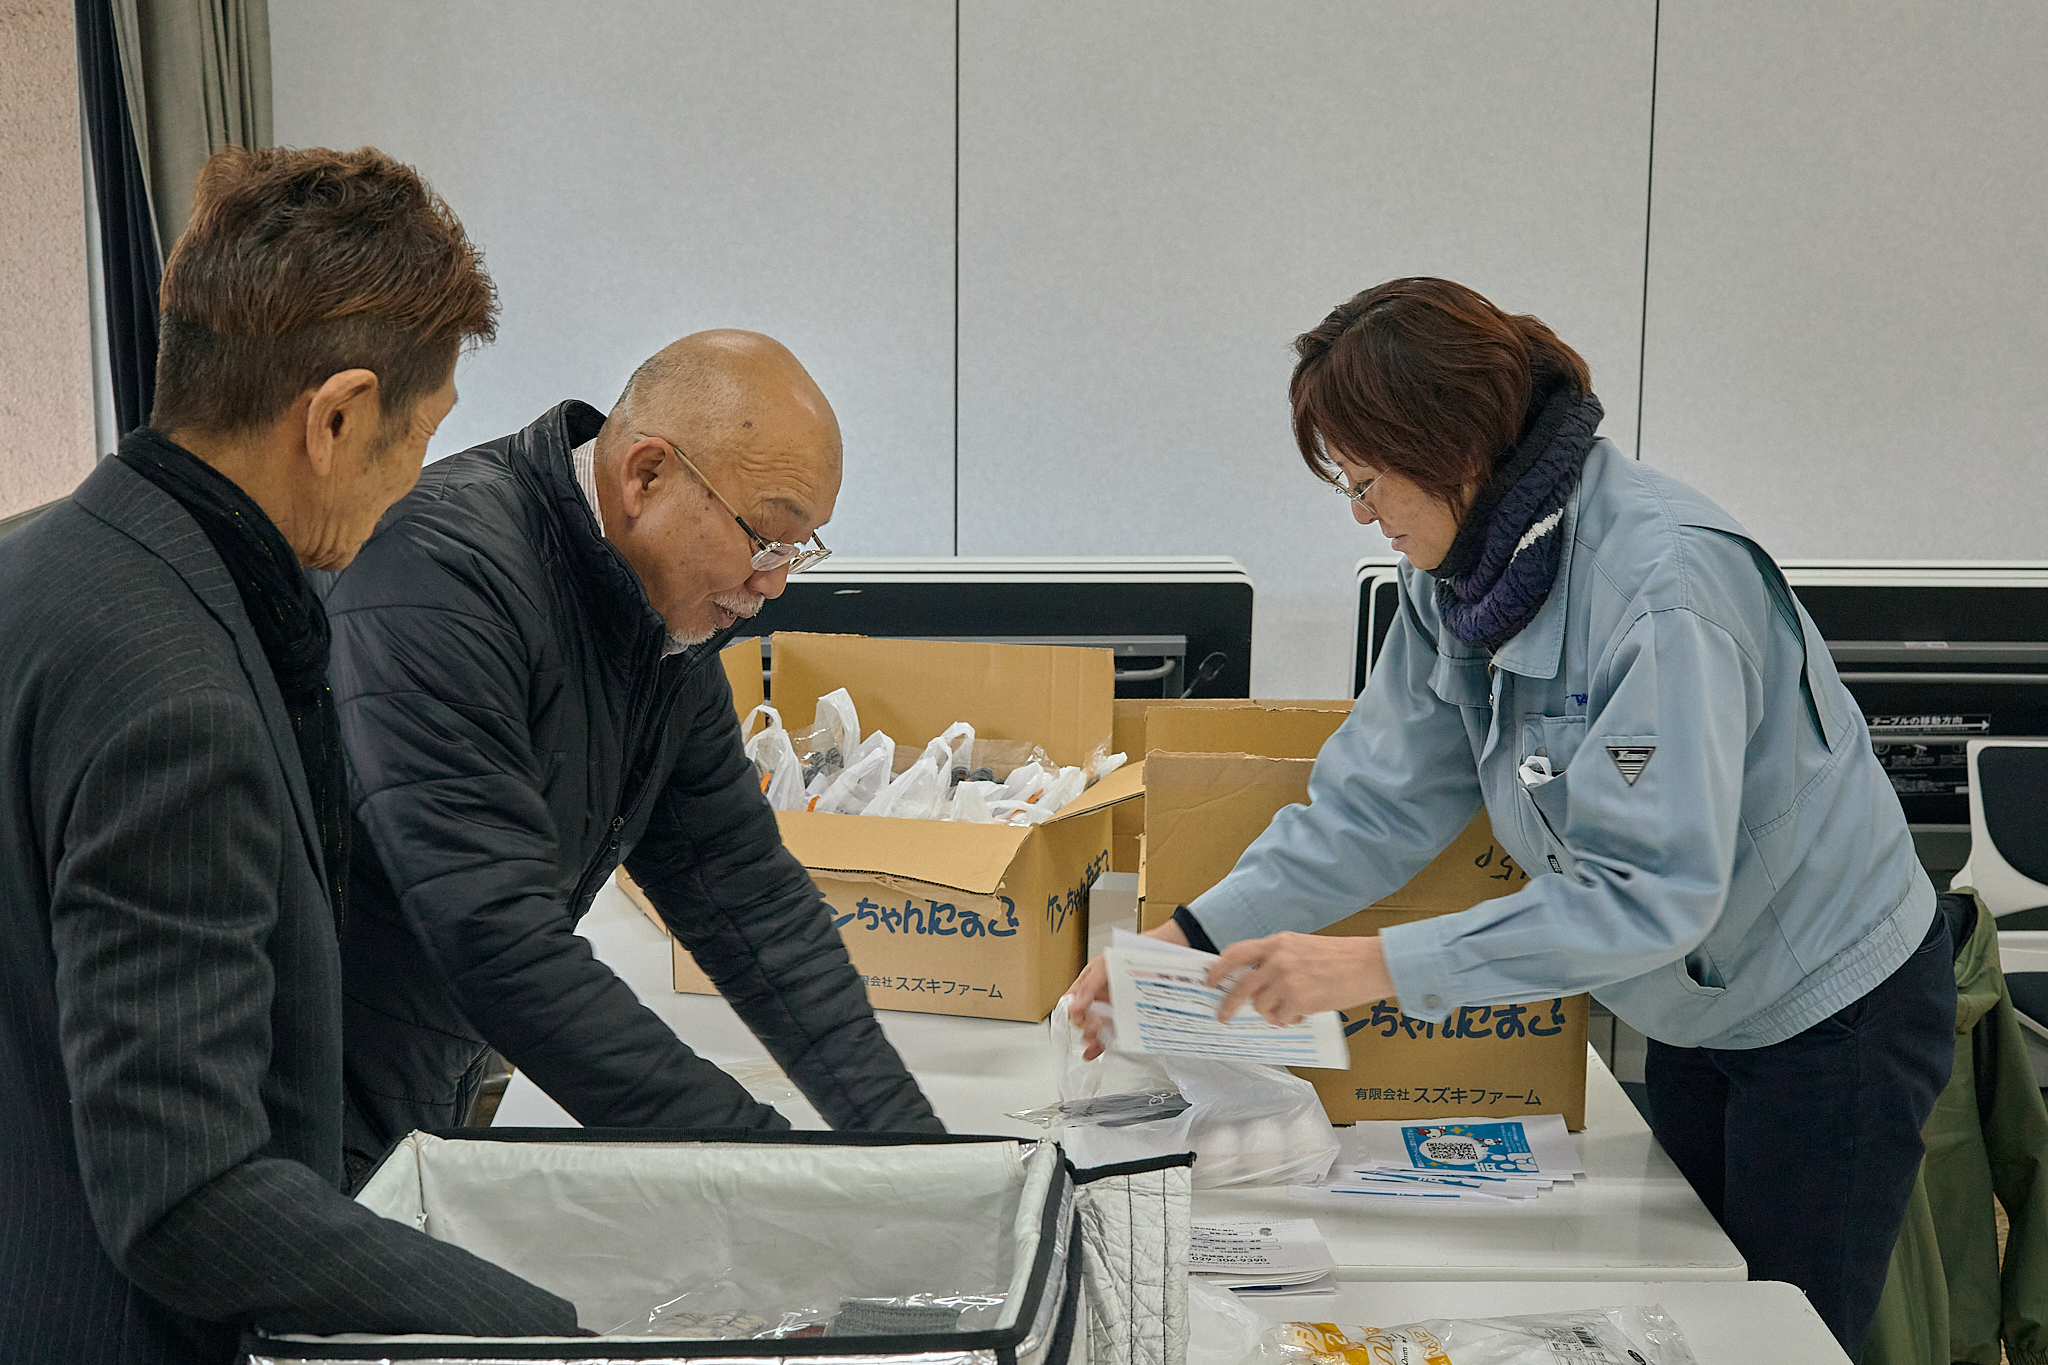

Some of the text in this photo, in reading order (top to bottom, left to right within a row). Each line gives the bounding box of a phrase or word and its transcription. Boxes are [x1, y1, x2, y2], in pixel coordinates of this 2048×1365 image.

[1872, 715, 1963, 726] テーブルの移動方向
[819, 891, 1019, 938] ンちゃんたまご
[896, 976, 1003, 999] スズキファーム
[1355, 1087, 1542, 1106] 有限会社 スズキファーム
